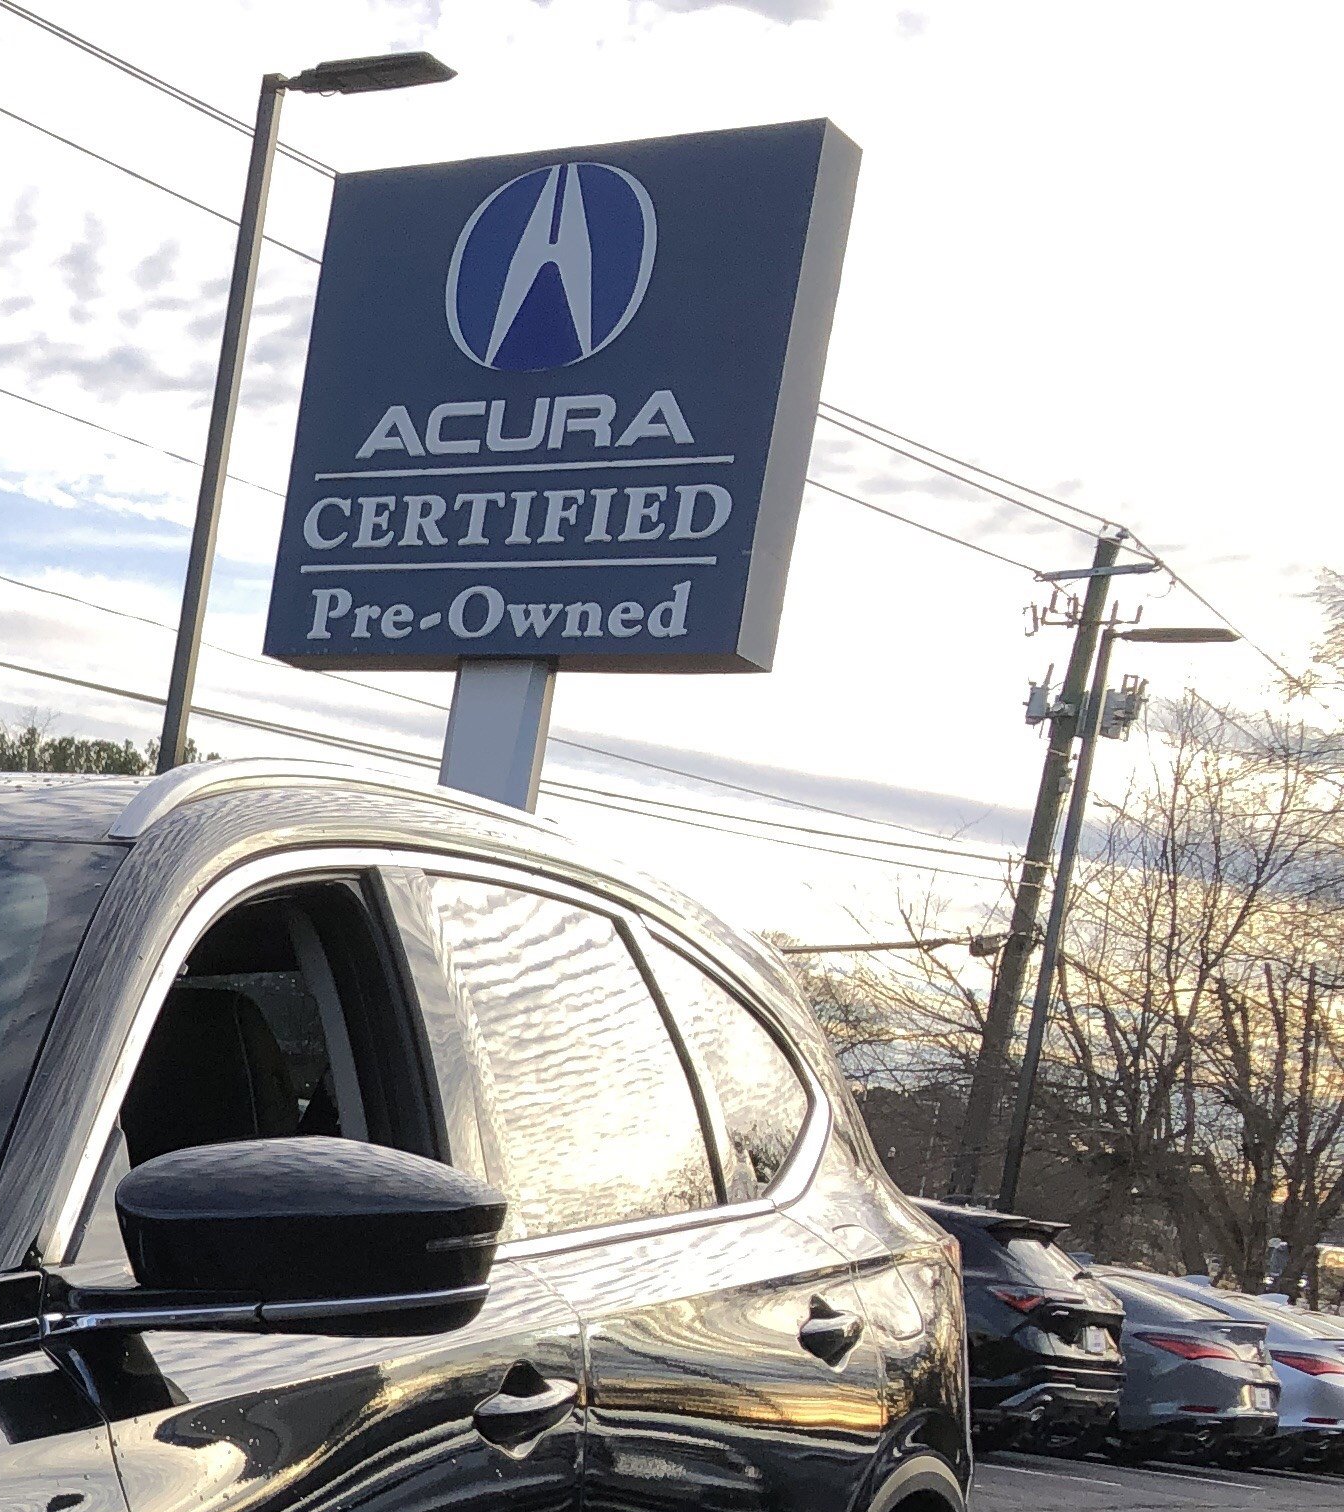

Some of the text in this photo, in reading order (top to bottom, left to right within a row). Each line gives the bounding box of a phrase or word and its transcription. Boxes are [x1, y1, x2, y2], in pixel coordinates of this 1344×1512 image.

[355, 390, 695, 459] ACURA
[303, 484, 733, 550] CERTIFIED
[306, 580, 691, 640] Pre-Owned
